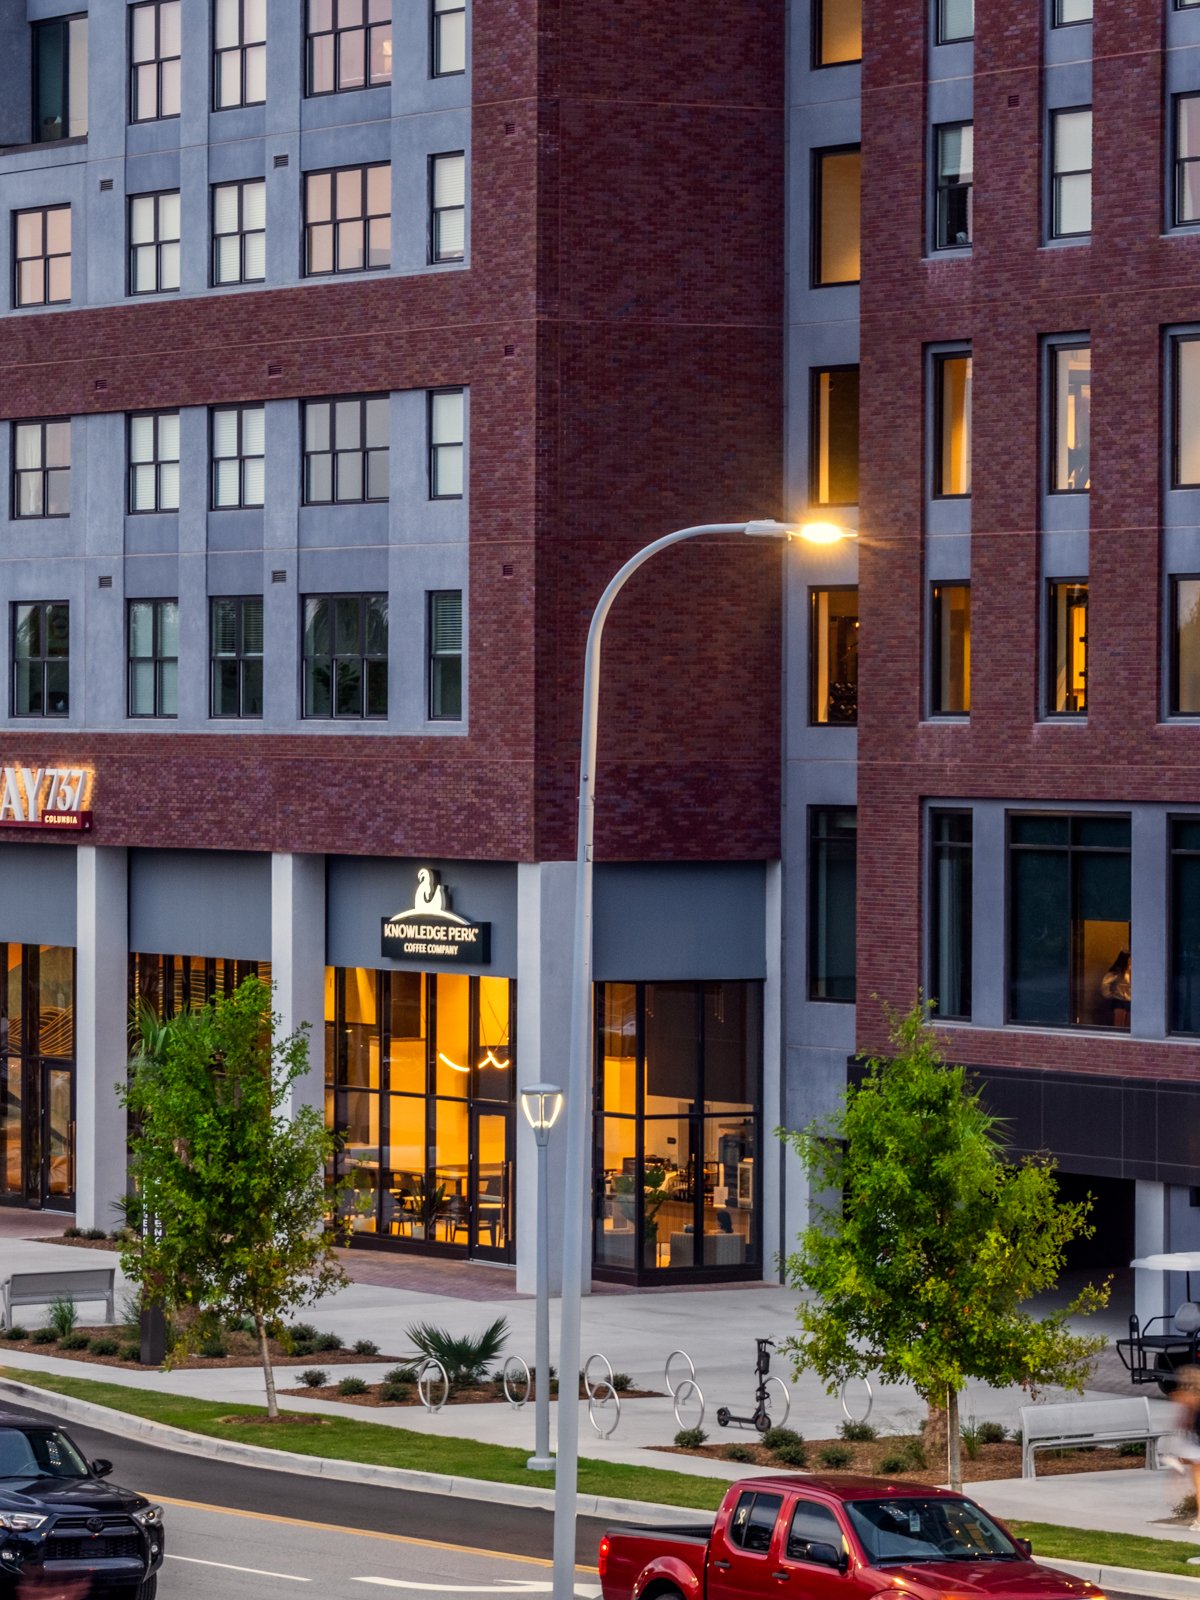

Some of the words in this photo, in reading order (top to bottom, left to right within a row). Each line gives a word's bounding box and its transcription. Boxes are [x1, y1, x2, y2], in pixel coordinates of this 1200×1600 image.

[44, 815, 78, 824] COLUMBIA
[384, 924, 447, 940] KNOWLEDGE
[404, 943, 427, 953] COFFEE
[427, 944, 459, 955] COMPANY
